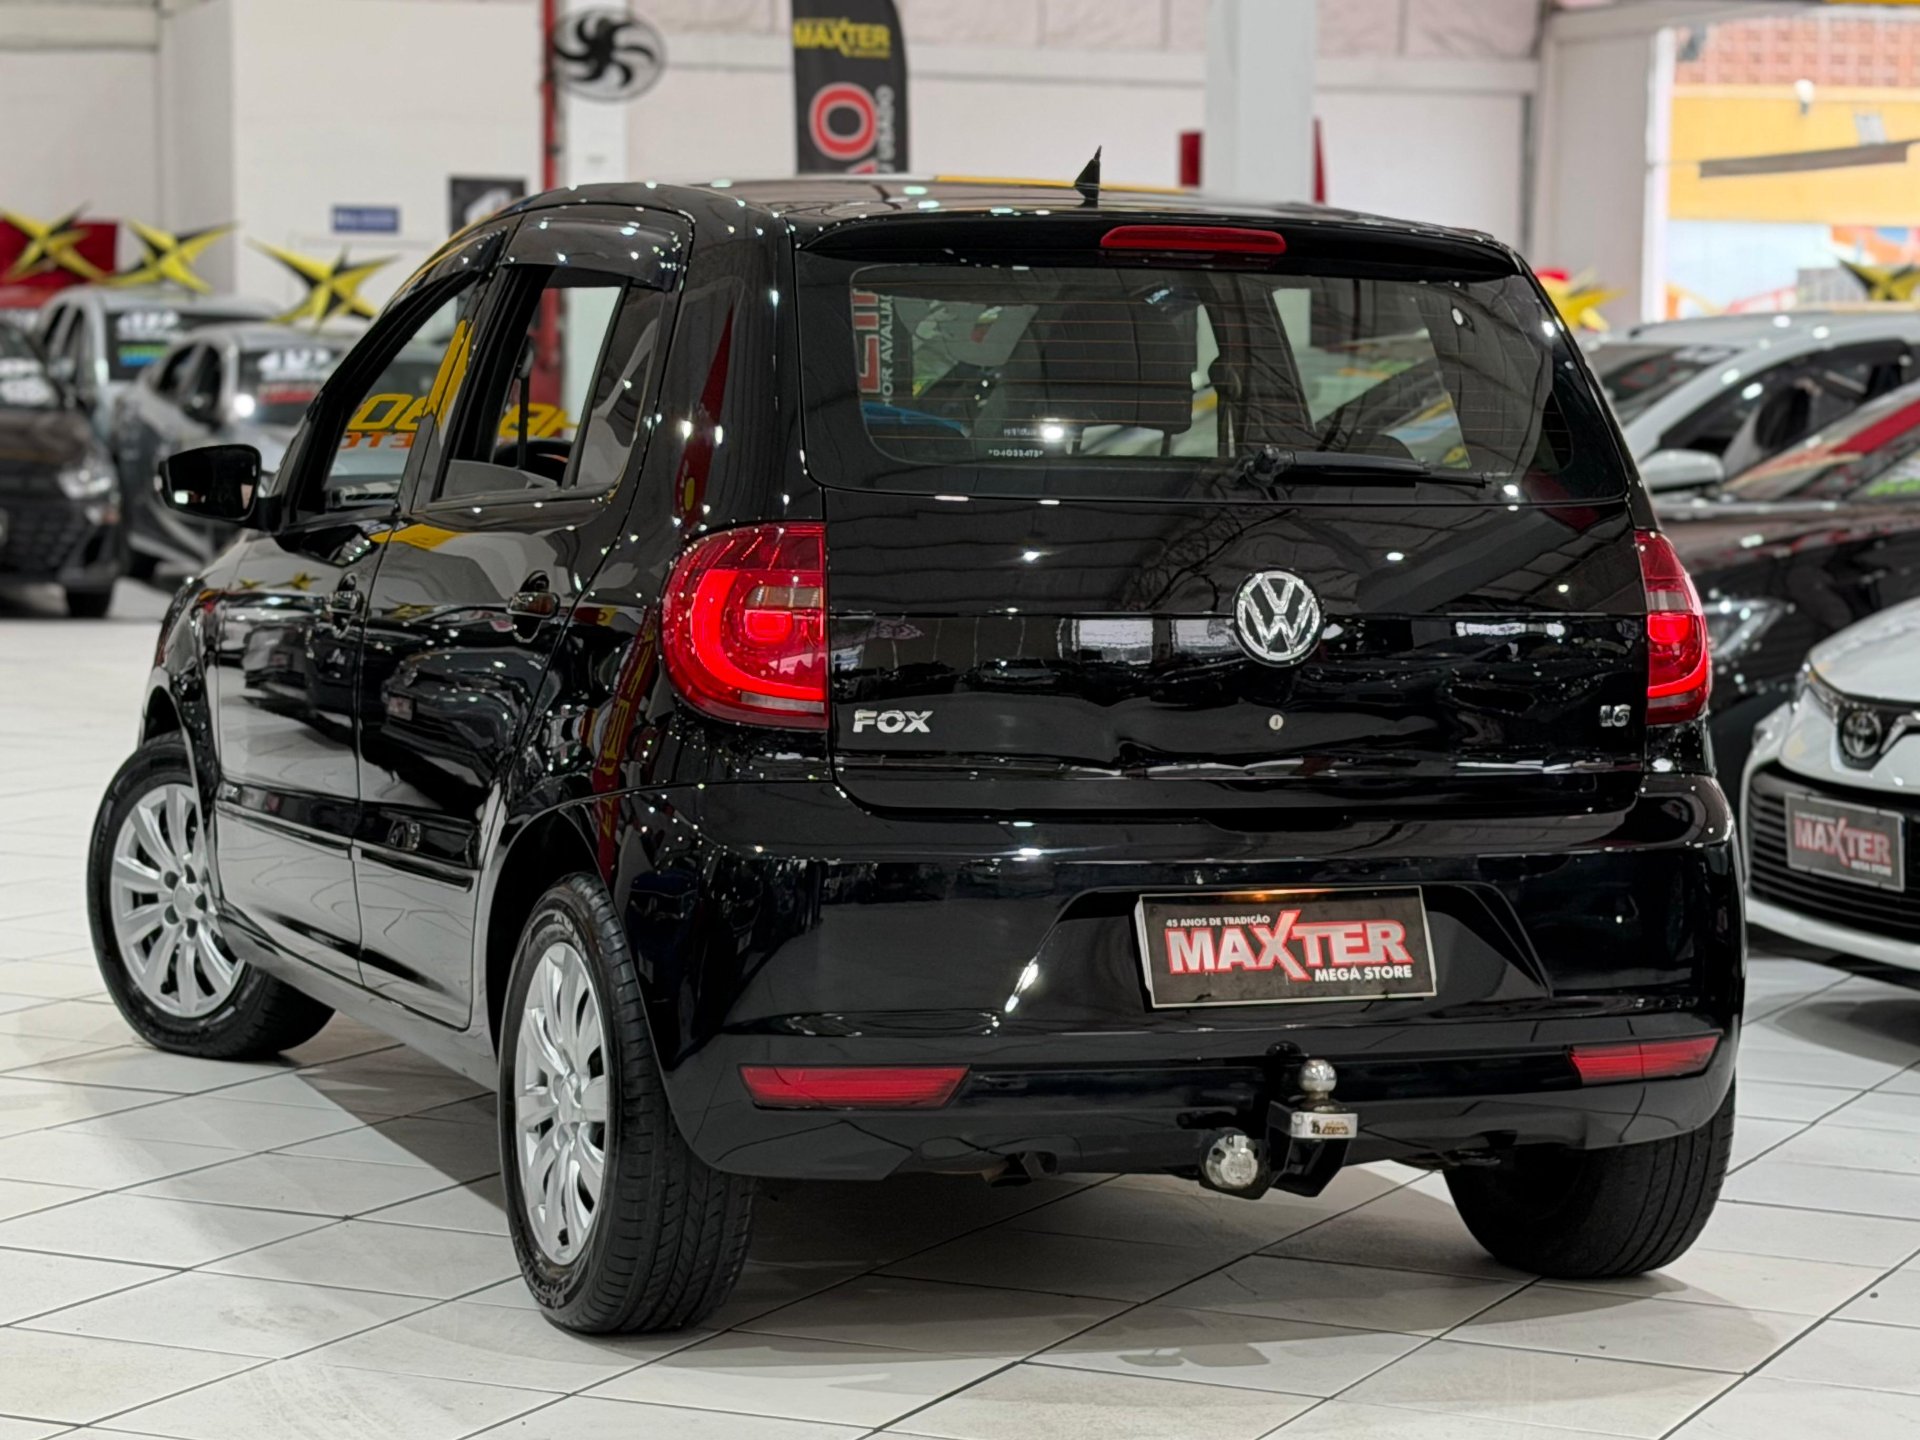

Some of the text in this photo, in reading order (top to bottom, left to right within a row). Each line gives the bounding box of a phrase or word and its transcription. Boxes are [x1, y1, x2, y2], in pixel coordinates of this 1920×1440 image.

[794, 18, 890, 57] MAXTER
[853, 709, 934, 734] FOX
[1794, 816, 1892, 868] MAXTER
[1166, 914, 1271, 928] 45 ANOS DE TRADIÇÃO
[1164, 909, 1414, 982] MAXTER
[1315, 965, 1413, 982] MEGA STORE
